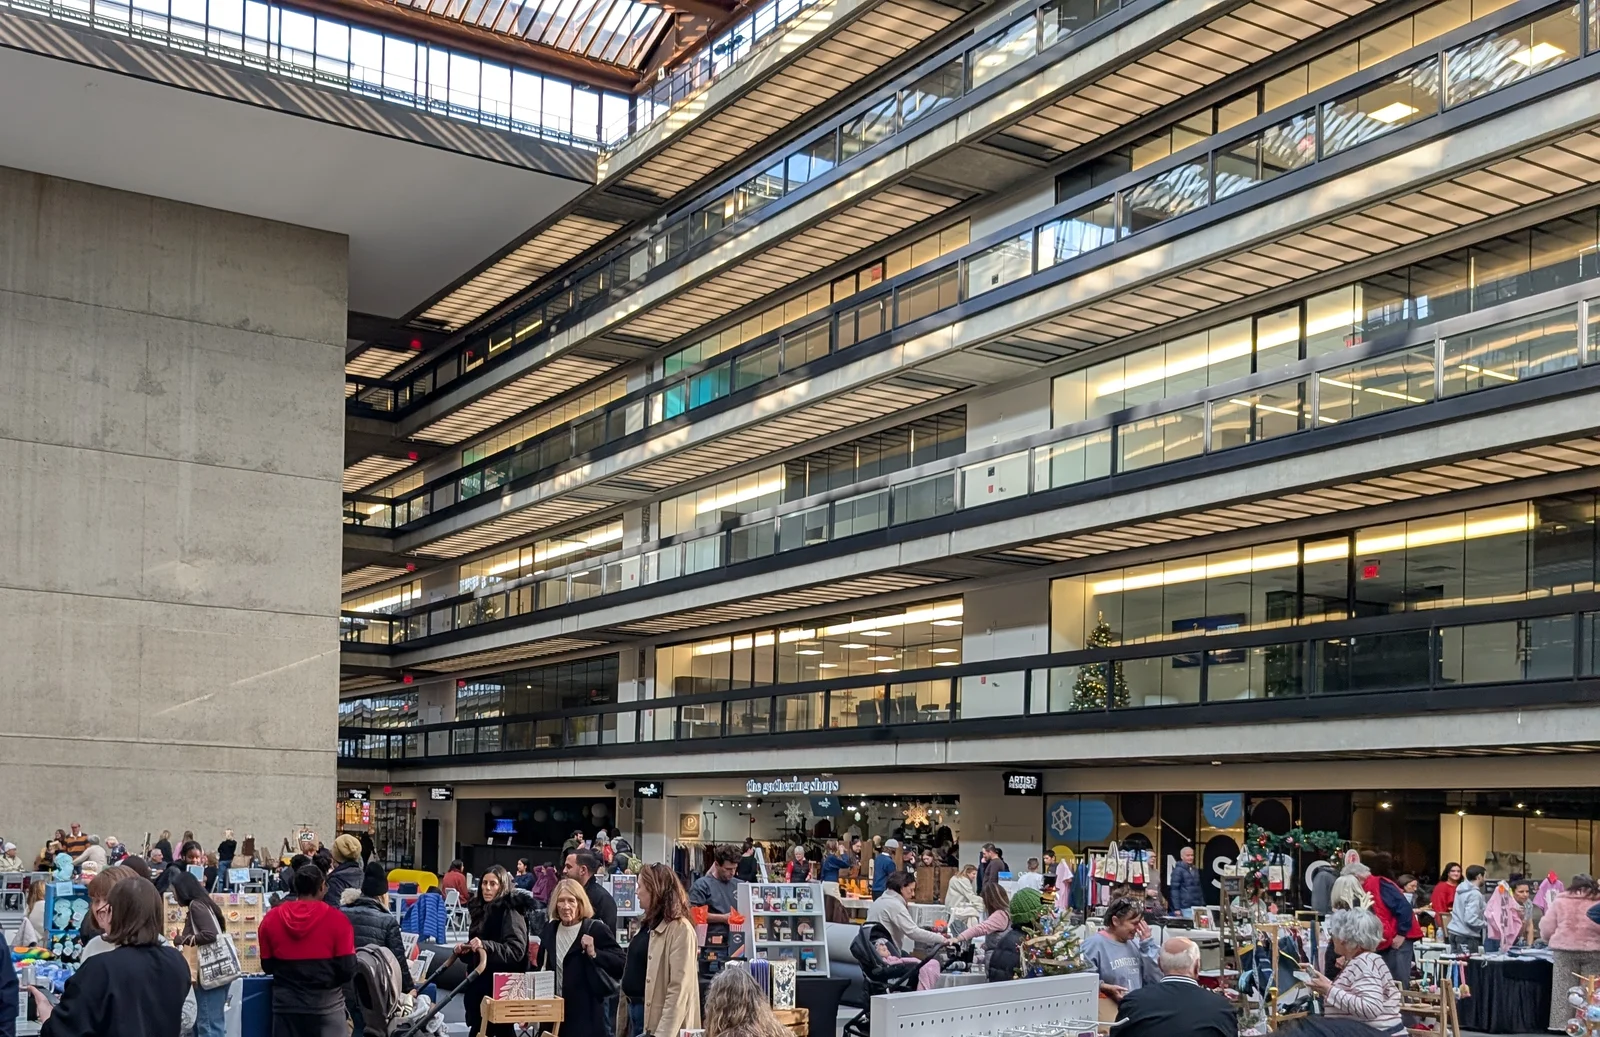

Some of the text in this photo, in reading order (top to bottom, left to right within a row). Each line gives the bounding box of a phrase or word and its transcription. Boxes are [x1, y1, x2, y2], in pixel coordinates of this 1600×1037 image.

[746, 775, 839, 795] the gathering shops
[1009, 776, 1035, 784] ARTIST
